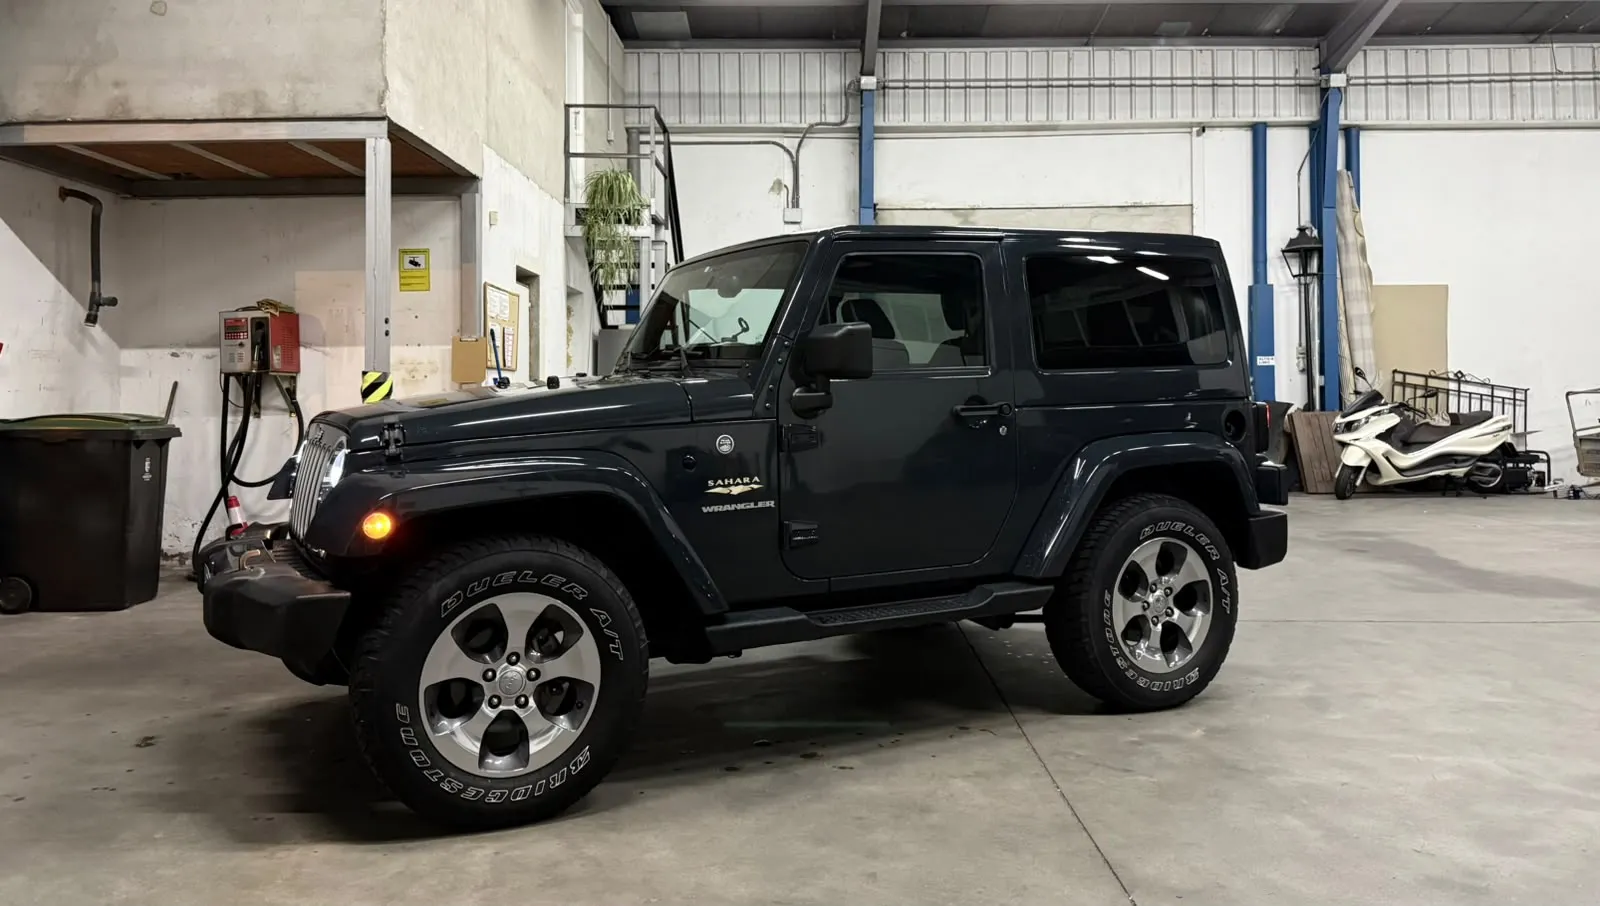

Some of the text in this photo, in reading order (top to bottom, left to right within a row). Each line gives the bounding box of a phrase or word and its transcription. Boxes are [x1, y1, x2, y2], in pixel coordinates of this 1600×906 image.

[701, 500, 776, 513] WRANGLER
[707, 476, 760, 487] SAHARA
[1139, 521, 1231, 615] DUELER A/T
[440, 570, 625, 661] DUELER A/T
[1104, 590, 1201, 692] BRIDGESTONE
[395, 702, 591, 804] BRIDGESTONE
